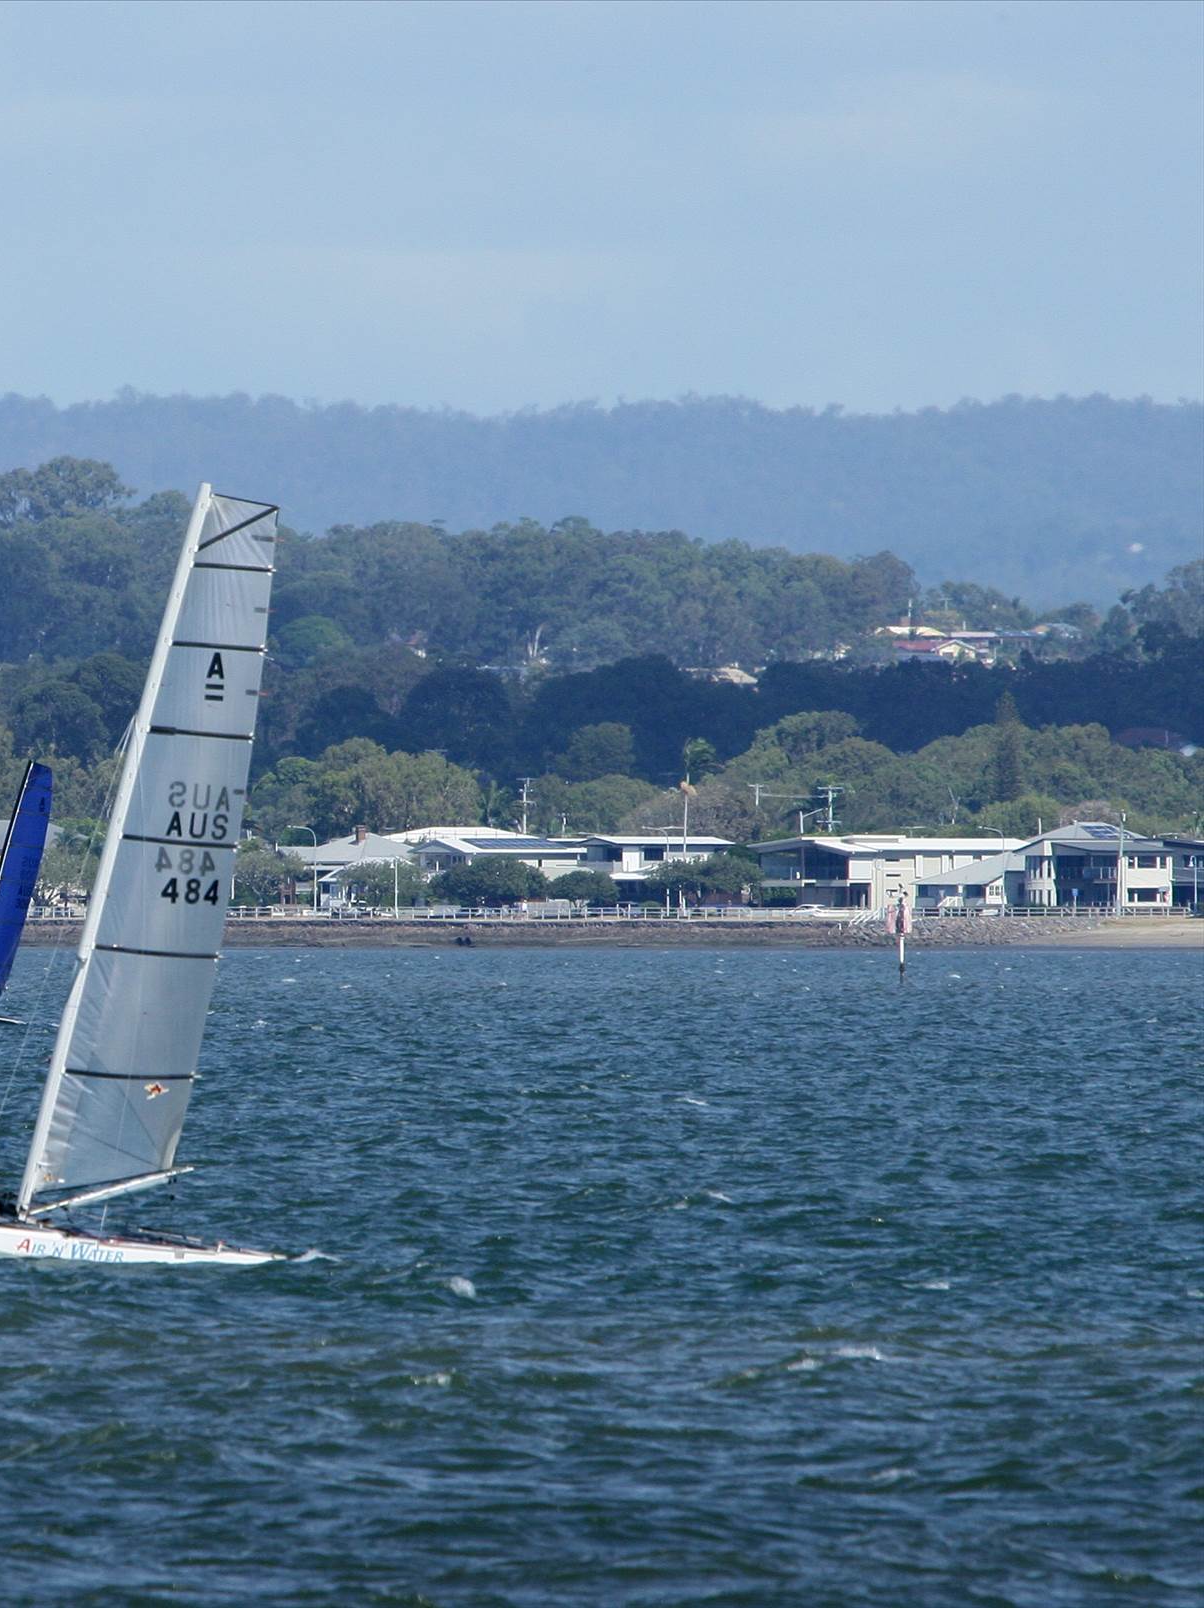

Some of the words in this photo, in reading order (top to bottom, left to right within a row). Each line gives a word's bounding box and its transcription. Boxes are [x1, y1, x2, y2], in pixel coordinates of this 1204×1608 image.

[206, 652, 225, 680] A
[165, 811, 229, 840] AUS
[160, 877, 220, 905] 484
